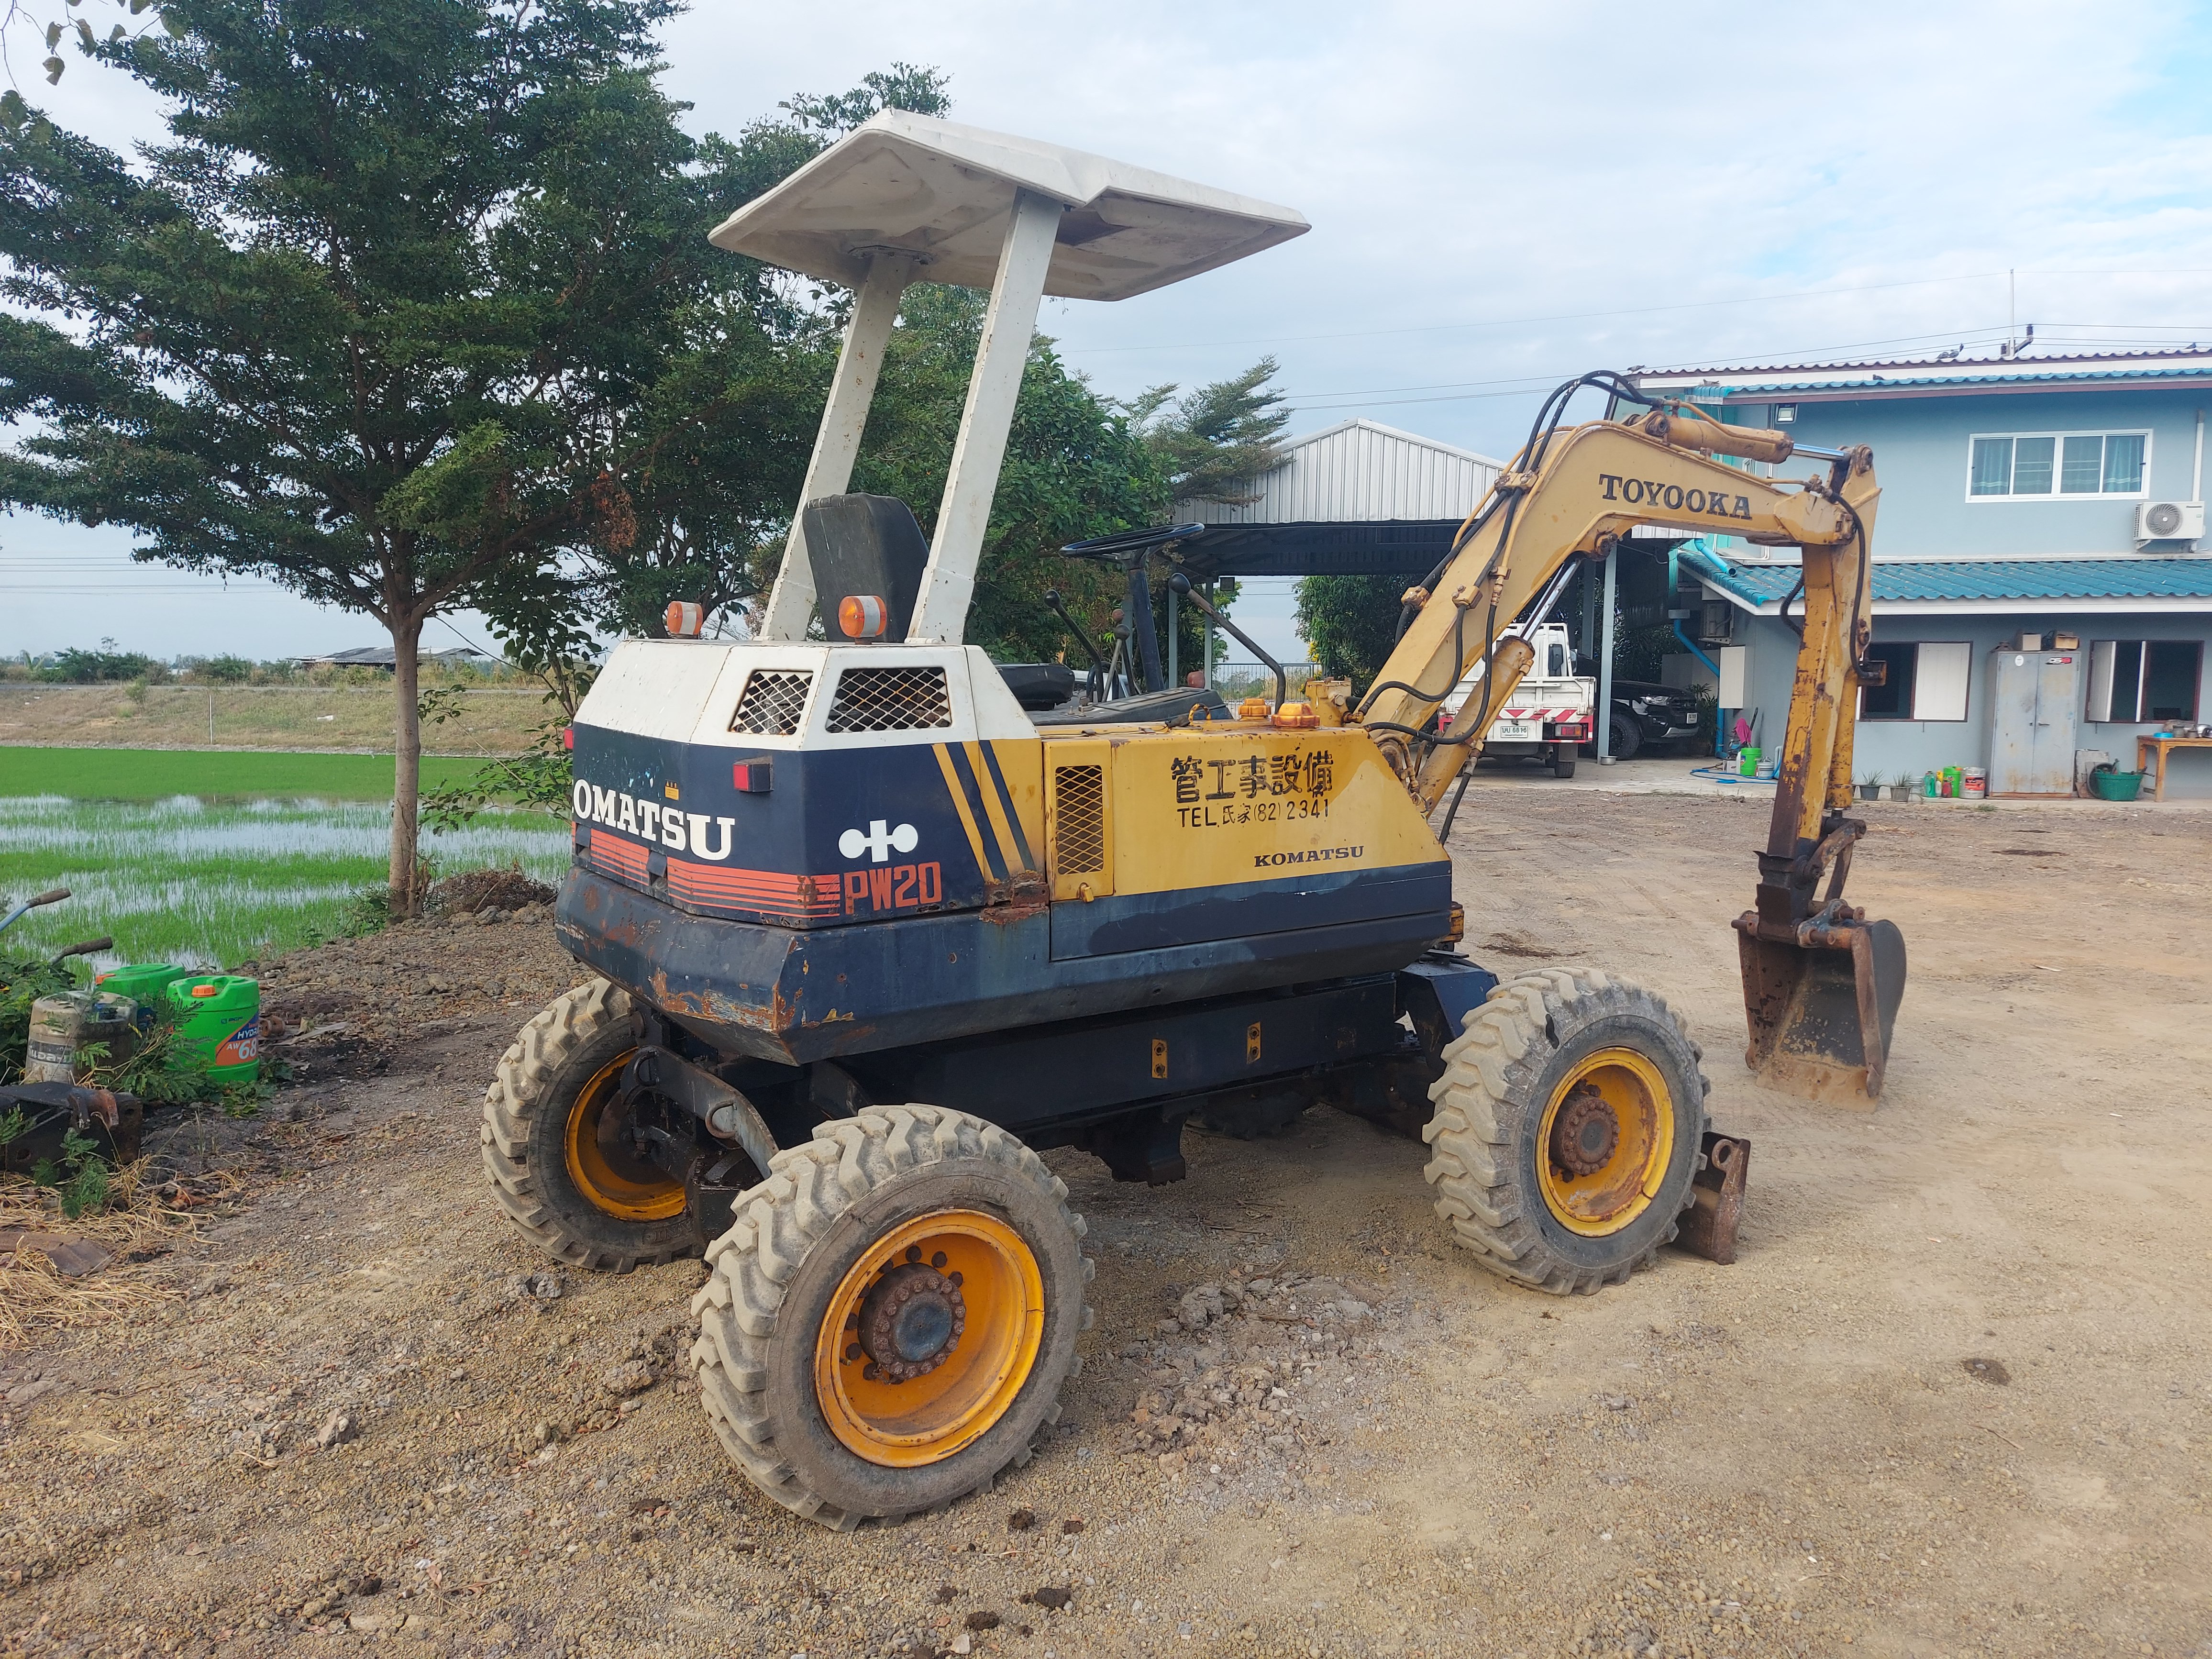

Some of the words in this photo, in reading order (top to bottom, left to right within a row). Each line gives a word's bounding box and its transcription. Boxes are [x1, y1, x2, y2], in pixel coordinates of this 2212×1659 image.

[1599, 474, 1752, 520] TOYOOKA
[1171, 750, 1333, 804] 管工事設備
[572, 779, 735, 861] OMATSU
[1254, 846, 1364, 867] KOMATSU
[843, 862, 942, 915] PW20
[238, 1038, 257, 1060] 68
